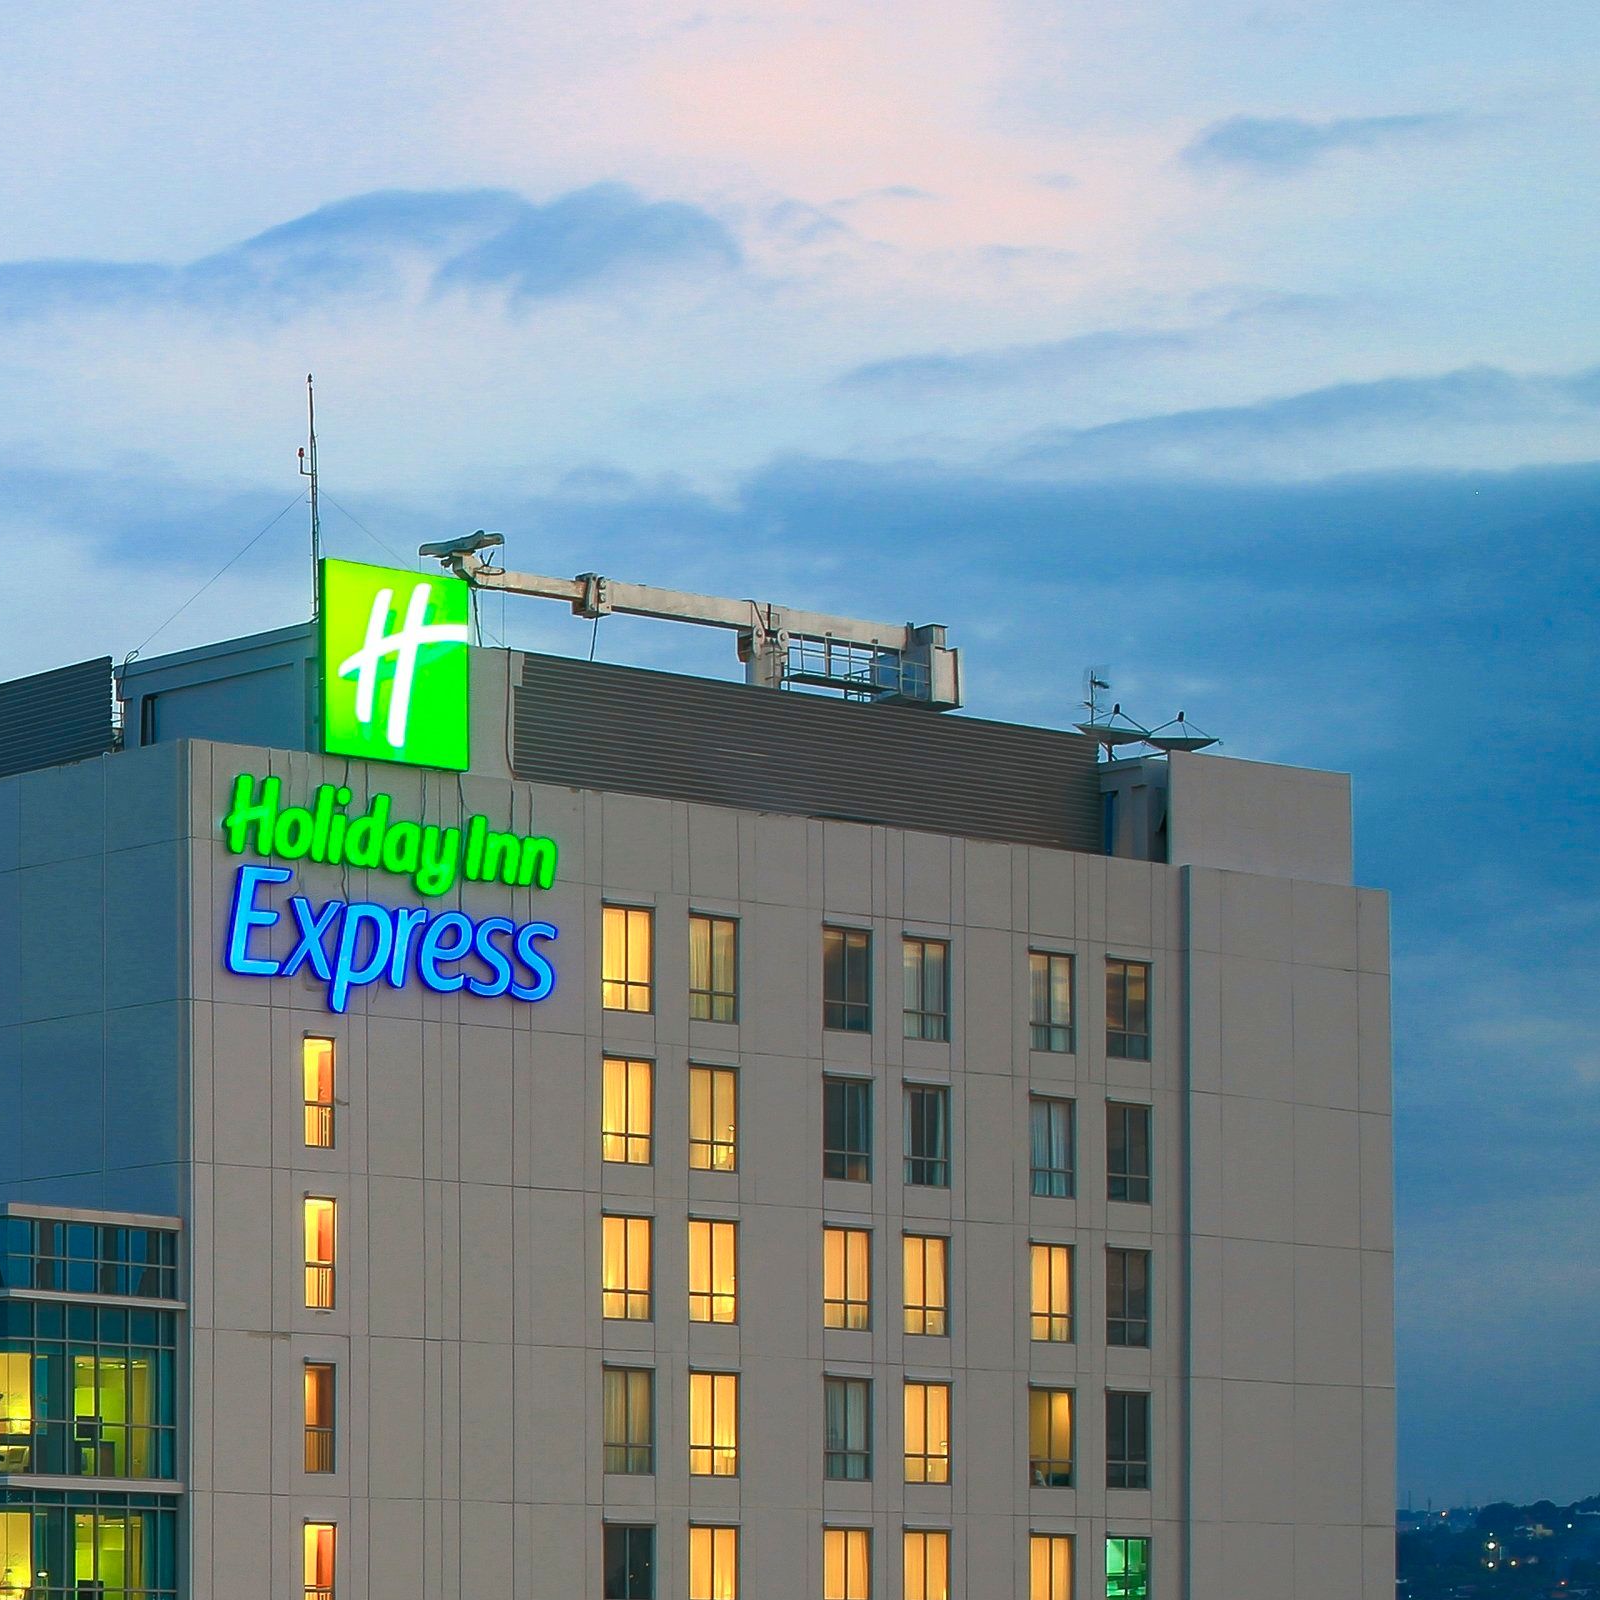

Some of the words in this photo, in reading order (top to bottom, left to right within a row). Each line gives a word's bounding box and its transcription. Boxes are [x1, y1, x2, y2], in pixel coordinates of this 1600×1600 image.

[224, 774, 461, 898] Holiday
[464, 814, 558, 891] Inn
[225, 864, 559, 1014] Express
